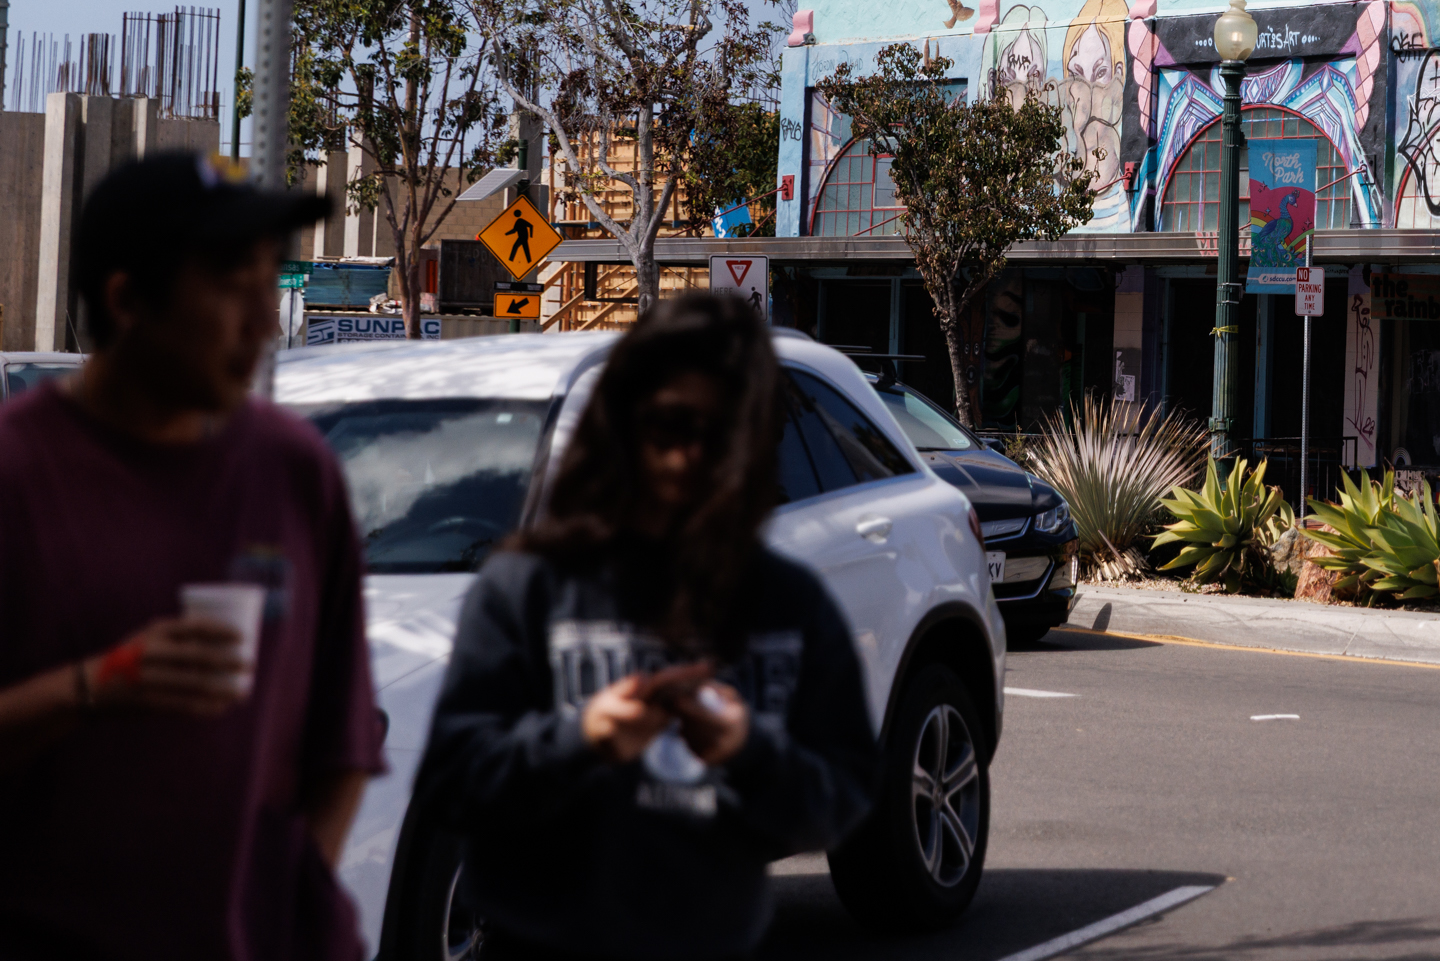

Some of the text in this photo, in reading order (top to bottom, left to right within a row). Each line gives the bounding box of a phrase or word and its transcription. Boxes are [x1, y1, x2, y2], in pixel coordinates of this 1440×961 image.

[1262, 152, 1302, 173] North
[1274, 167, 1305, 183] Park
[1298, 269, 1307, 280] NO
[1298, 284, 1322, 294] PARKING
[1373, 274, 1408, 297] the
[1304, 294, 1315, 302] ANY
[1304, 302, 1315, 311] TIME
[338, 319, 440, 334] SUNPC
